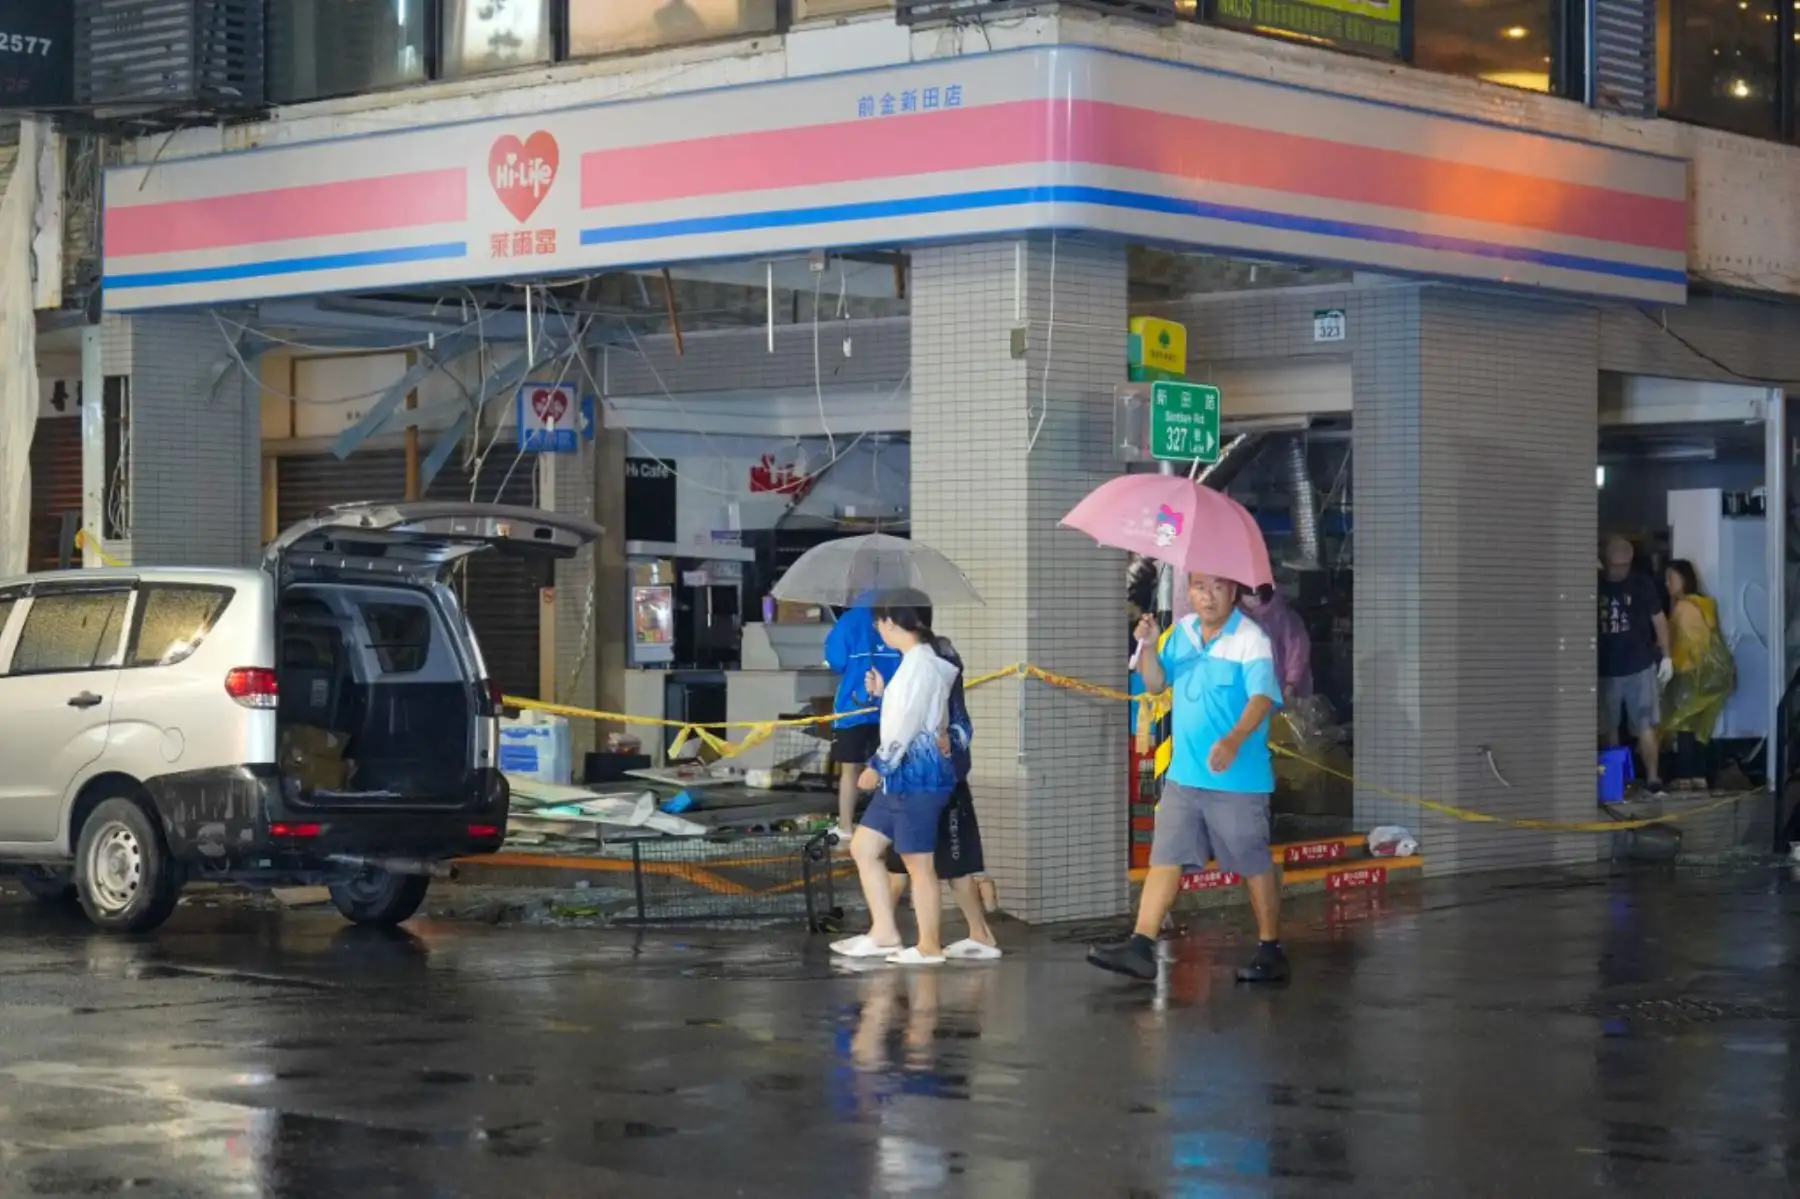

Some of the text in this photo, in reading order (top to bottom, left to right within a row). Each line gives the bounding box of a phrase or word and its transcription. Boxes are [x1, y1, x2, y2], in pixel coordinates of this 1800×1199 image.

[0, 32, 52, 57] 2577
[858, 84, 962, 118] 前金新田店
[490, 228, 556, 259] 萊爾富
[1166, 425, 1188, 453] 327
